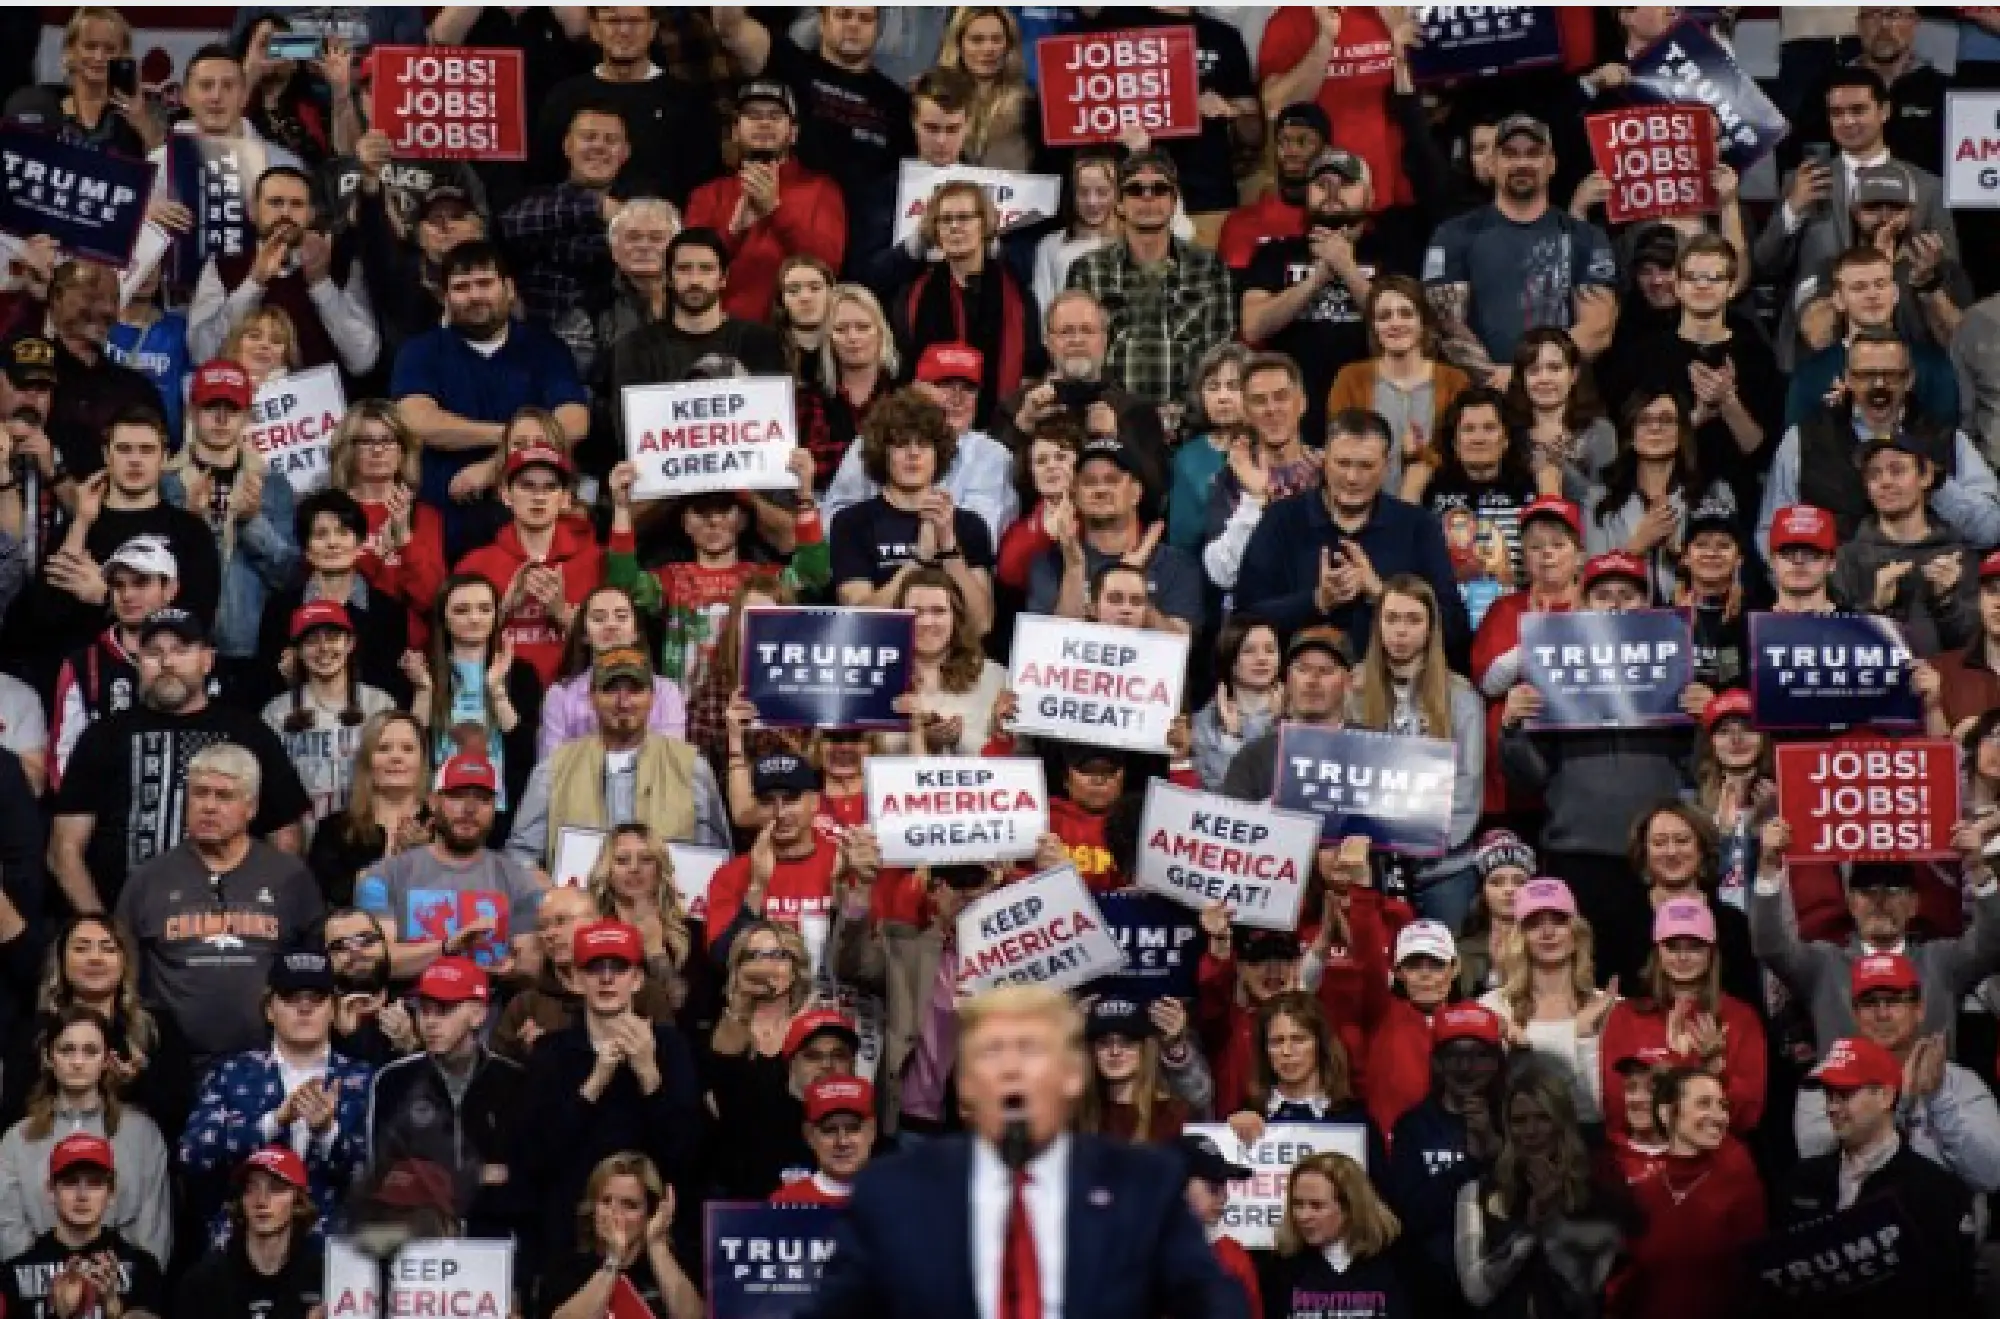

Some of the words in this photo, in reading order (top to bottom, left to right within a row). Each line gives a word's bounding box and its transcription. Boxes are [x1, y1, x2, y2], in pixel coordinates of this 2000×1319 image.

[396, 56, 496, 85] JOBS!
[1065, 37, 1168, 72] JOBS!
[1068, 68, 1171, 103] JOBS!
[394, 87, 496, 117] JOBS!
[1071, 100, 1171, 134] JOBS!
[397, 119, 498, 150] JOBS!
[1606, 114, 1694, 148] JOBS!
[3, 150, 136, 206] TRUMP
[1613, 145, 1700, 180] JOBS!
[1620, 176, 1703, 212] JOBS!
[252, 393, 298, 422] EEP
[671, 393, 747, 421] KEEP
[636, 419, 785, 454] AMERICA
[661, 450, 768, 480] GREAT!
[757, 641, 900, 667] TRUMP
[1062, 637, 1138, 667] KEEP
[1532, 641, 1678, 667] TRUMP
[1763, 644, 1912, 667] TRUMP
[768, 665, 886, 685] PENCE
[1018, 661, 1170, 707] AMERICA
[1549, 666, 1666, 683] PENCE
[1778, 669, 1900, 686] PENCE
[1038, 694, 1146, 733] GREAT!
[916, 769, 994, 788] KEEP
[1808, 751, 1928, 784] JOBS!
[881, 788, 1039, 816] AMERICA
[1810, 786, 1931, 818] JOBS!
[904, 818, 1017, 848] GREAT!
[1189, 811, 1270, 844] KEEP
[1812, 820, 1932, 852] JOBS!
[1148, 826, 1298, 885] AMERICA
[1166, 864, 1272, 909] GREAT!
[981, 895, 1044, 940] KEEP
[956, 911, 1099, 983] AMERICA
[719, 1237, 838, 1263] TRUM
[1762, 1225, 1900, 1288] TRUMP
[401, 1258, 458, 1282] EEP
